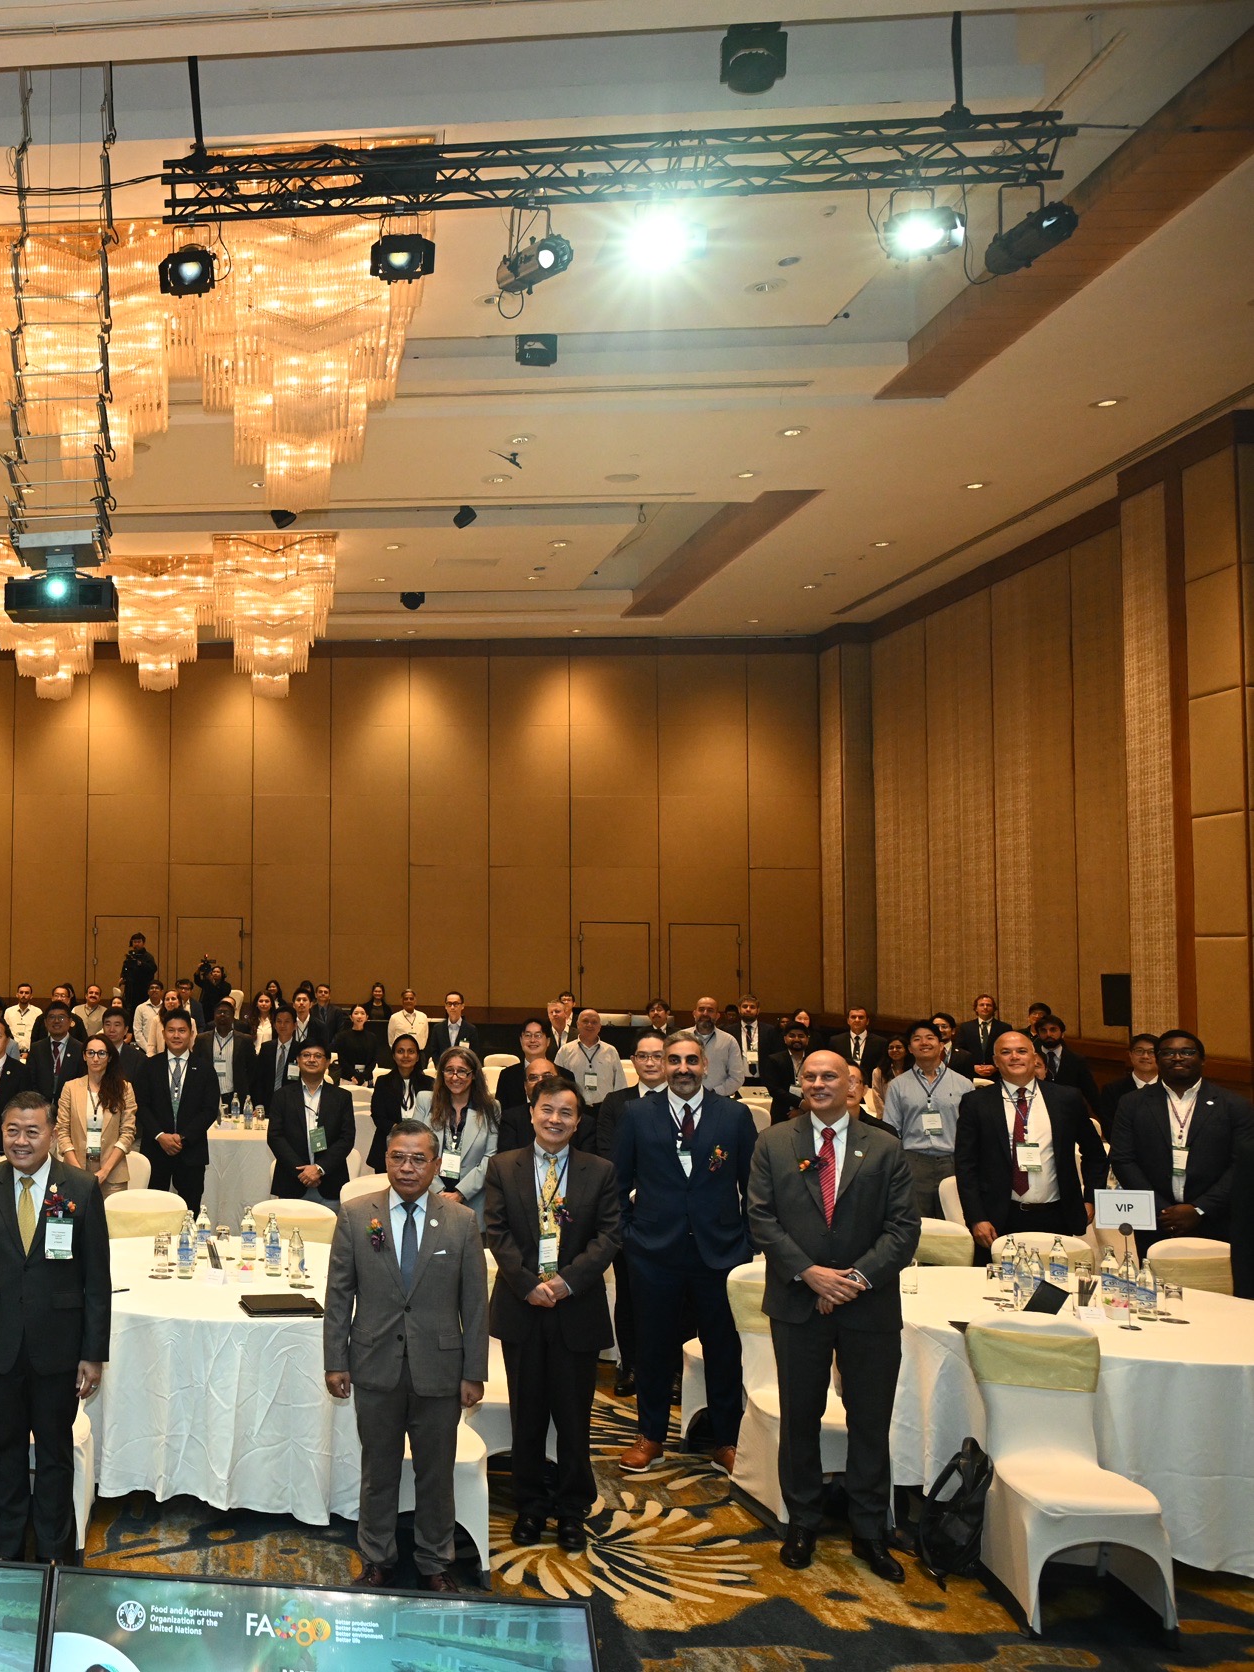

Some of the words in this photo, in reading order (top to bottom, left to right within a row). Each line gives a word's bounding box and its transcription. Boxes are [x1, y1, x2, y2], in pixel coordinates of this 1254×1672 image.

[1115, 1204, 1134, 1212] VIP
[151, 1605, 168, 1613] Food
[170, 1606, 183, 1614] and
[184, 1607, 224, 1618] Agriculture
[150, 1614, 195, 1625] Organization
[206, 1618, 218, 1627] the
[150, 1624, 173, 1633] United
[175, 1625, 202, 1635] Nations
